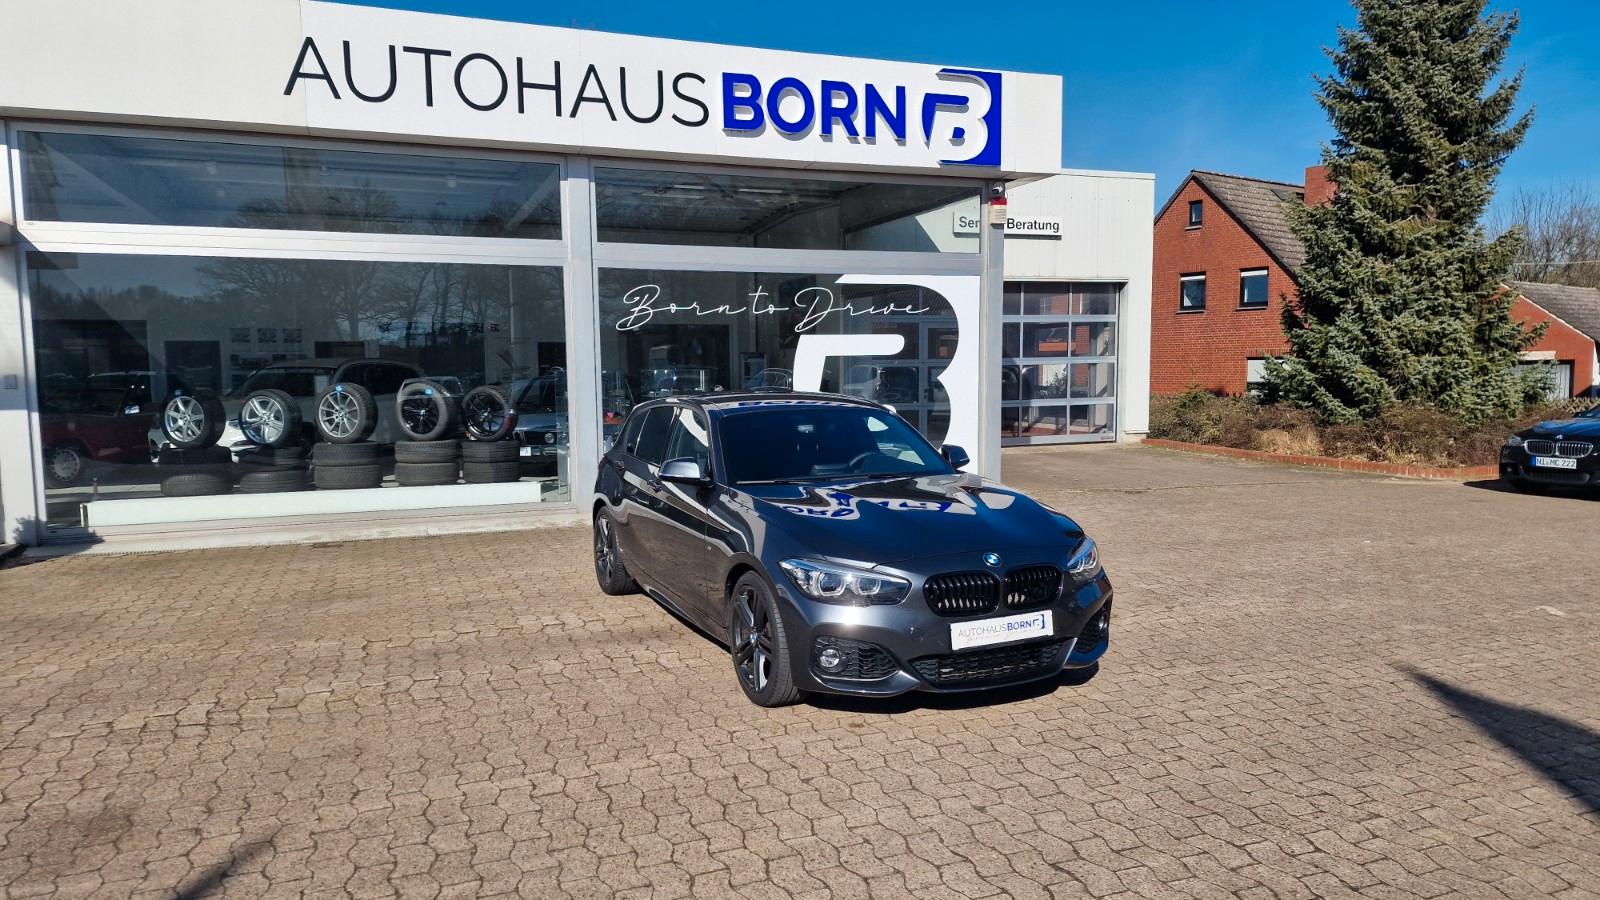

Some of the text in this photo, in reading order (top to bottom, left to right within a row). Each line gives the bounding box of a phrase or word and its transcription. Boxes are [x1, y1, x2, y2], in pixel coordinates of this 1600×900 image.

[1006, 218, 1060, 233] Beratung
[616, 284, 930, 333] Born to Drive
